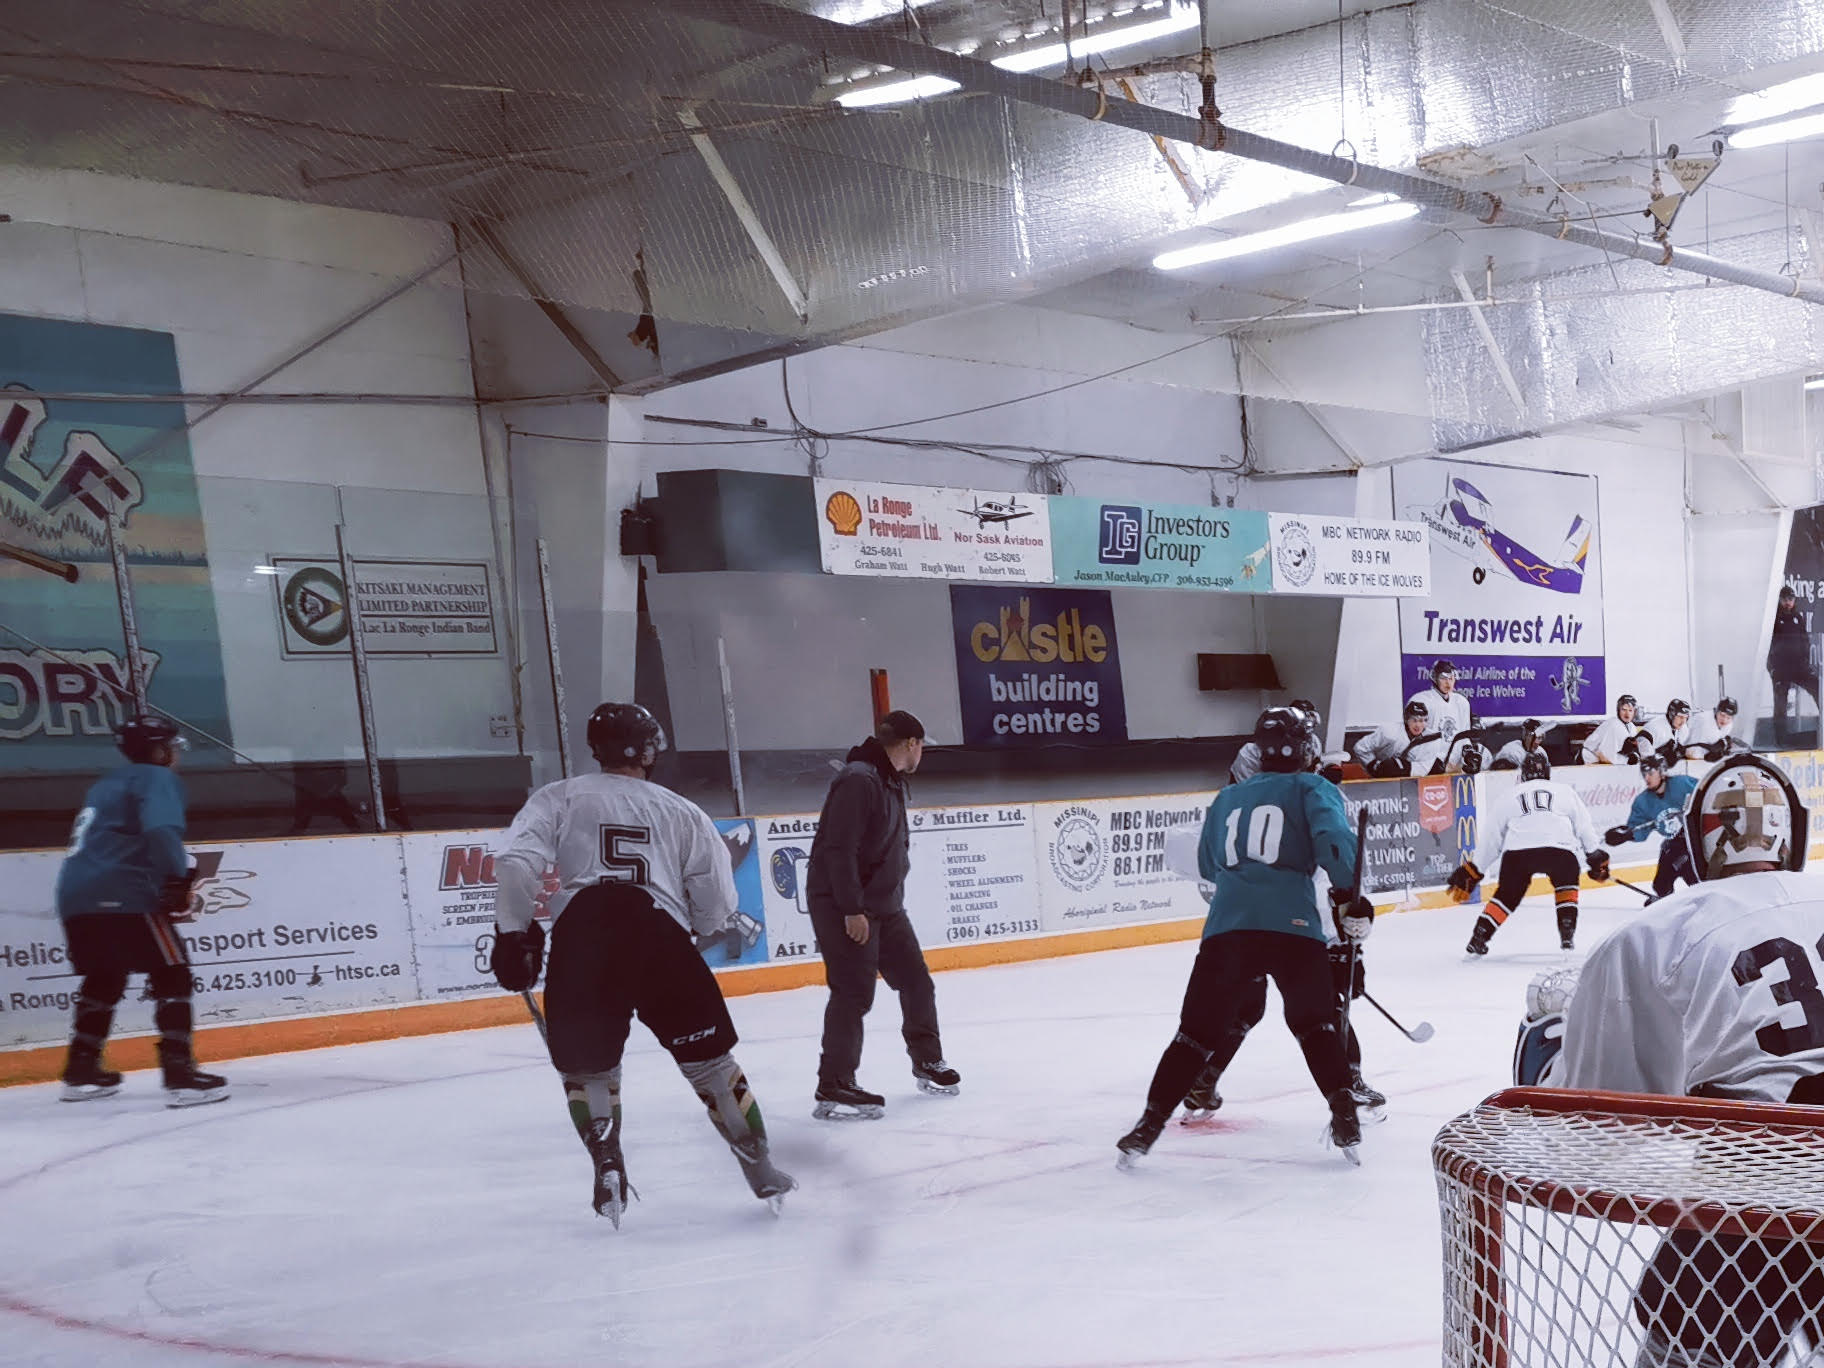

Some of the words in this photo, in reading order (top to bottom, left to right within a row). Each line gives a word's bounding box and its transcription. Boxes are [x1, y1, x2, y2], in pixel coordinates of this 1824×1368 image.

[867, 495, 879, 513] La
[882, 496, 912, 518] Ronge
[869, 518, 921, 539] Petroleum
[1146, 509, 1230, 539] Investors
[954, 531, 973, 543] Nor
[976, 532, 1001, 545] Sask
[1003, 534, 1044, 546] Aviation
[1322, 526, 1342, 539] MBC
[1346, 527, 1391, 541] NETWORK
[1395, 530, 1422, 543] RADIO
[1463, 535, 1477, 550] Air
[1145, 535, 1201, 567] Group
[1352, 551, 1372, 564] 89.9
[1375, 551, 1390, 564] FM
[855, 559, 888, 571] Graham
[921, 562, 944, 575] Hugh
[1074, 570, 1103, 581] Jason
[1324, 572, 1346, 585] HOME
[1350, 573, 1359, 585] OF
[1361, 573, 1375, 586] THE
[1378, 574, 1390, 587] ICE
[1393, 575, 1423, 588] WOLVES
[356, 582, 404, 595] KITSAKI
[406, 583, 486, 596] MANAGEMENT
[359, 600, 410, 612] LIMITED
[412, 600, 488, 613] PARTNERSHIP
[384, 622, 396, 633] La
[399, 622, 430, 637] Ronge
[432, 622, 465, 634] Indian
[466, 622, 490, 634] Band
[1424, 610, 1543, 645] Transwest
[1549, 614, 1583, 644] Air
[1475, 667, 1507, 680] Airline
[1508, 667, 1519, 680] of
[1521, 668, 1536, 680] the
[989, 673, 1099, 707] building
[1477, 685, 1490, 698] Ice
[1492, 685, 1526, 698] Wolves
[993, 708, 1100, 734] centres
[768, 820, 821, 836] Ander
[913, 814, 924, 826] &
[932, 811, 989, 825] Muffler
[998, 809, 1026, 822] Ltd.
[1054, 807, 1100, 828] MISSINIPI
[1110, 811, 1142, 831] MBC
[1145, 807, 1202, 829] Network
[1225, 804, 1285, 867] 10
[1392, 822, 1421, 838] AND
[1112, 833, 1143, 853] 89.9
[1146, 831, 1165, 850] FM
[600, 823, 650, 887] 5
[1145, 854, 1164, 873] FM
[1375, 847, 1416, 865] LIVING
[1112, 902, 1137, 913] Radio
[1140, 898, 1172, 910] Network
[184, 928, 267, 956] nsport
[273, 922, 378, 947] Services
[946, 926, 979, 942] (306)
[985, 920, 1038, 936] 425-3133
[0, 943, 68, 968] Helic
[775, 942, 807, 958] Air
[194, 969, 297, 994] 6.425.3100
[335, 963, 400, 981] htsc.ca
[10, 992, 81, 1011] Ronge
[672, 1025, 717, 1045] CCM
